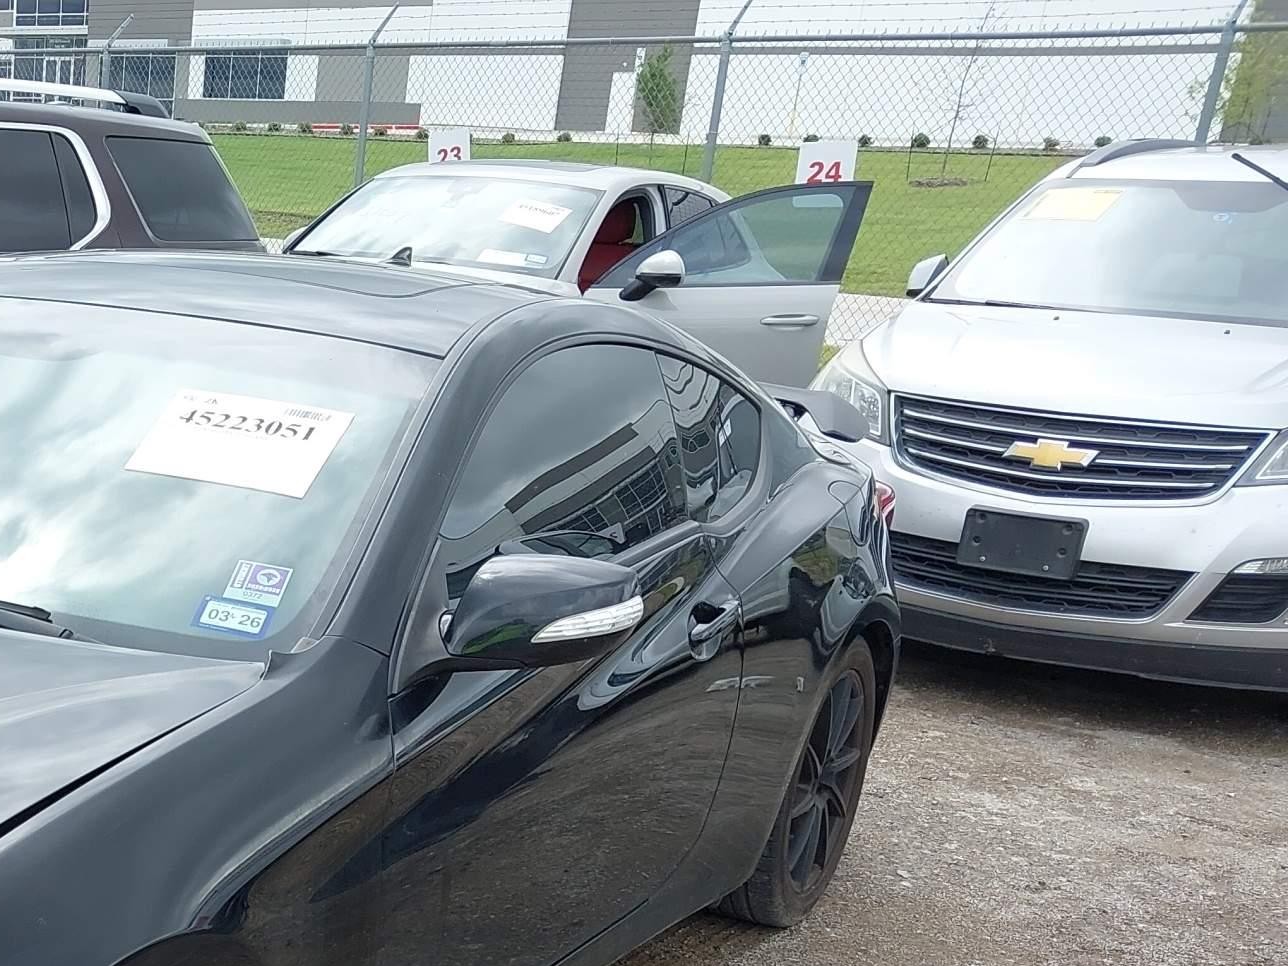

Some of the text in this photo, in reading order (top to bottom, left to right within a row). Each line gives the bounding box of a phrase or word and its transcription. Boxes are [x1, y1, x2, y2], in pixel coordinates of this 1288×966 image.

[437, 146, 462, 162] 23
[807, 161, 842, 184] 24
[179, 409, 316, 441] 45223051
[208, 608, 262, 628] 03 26
